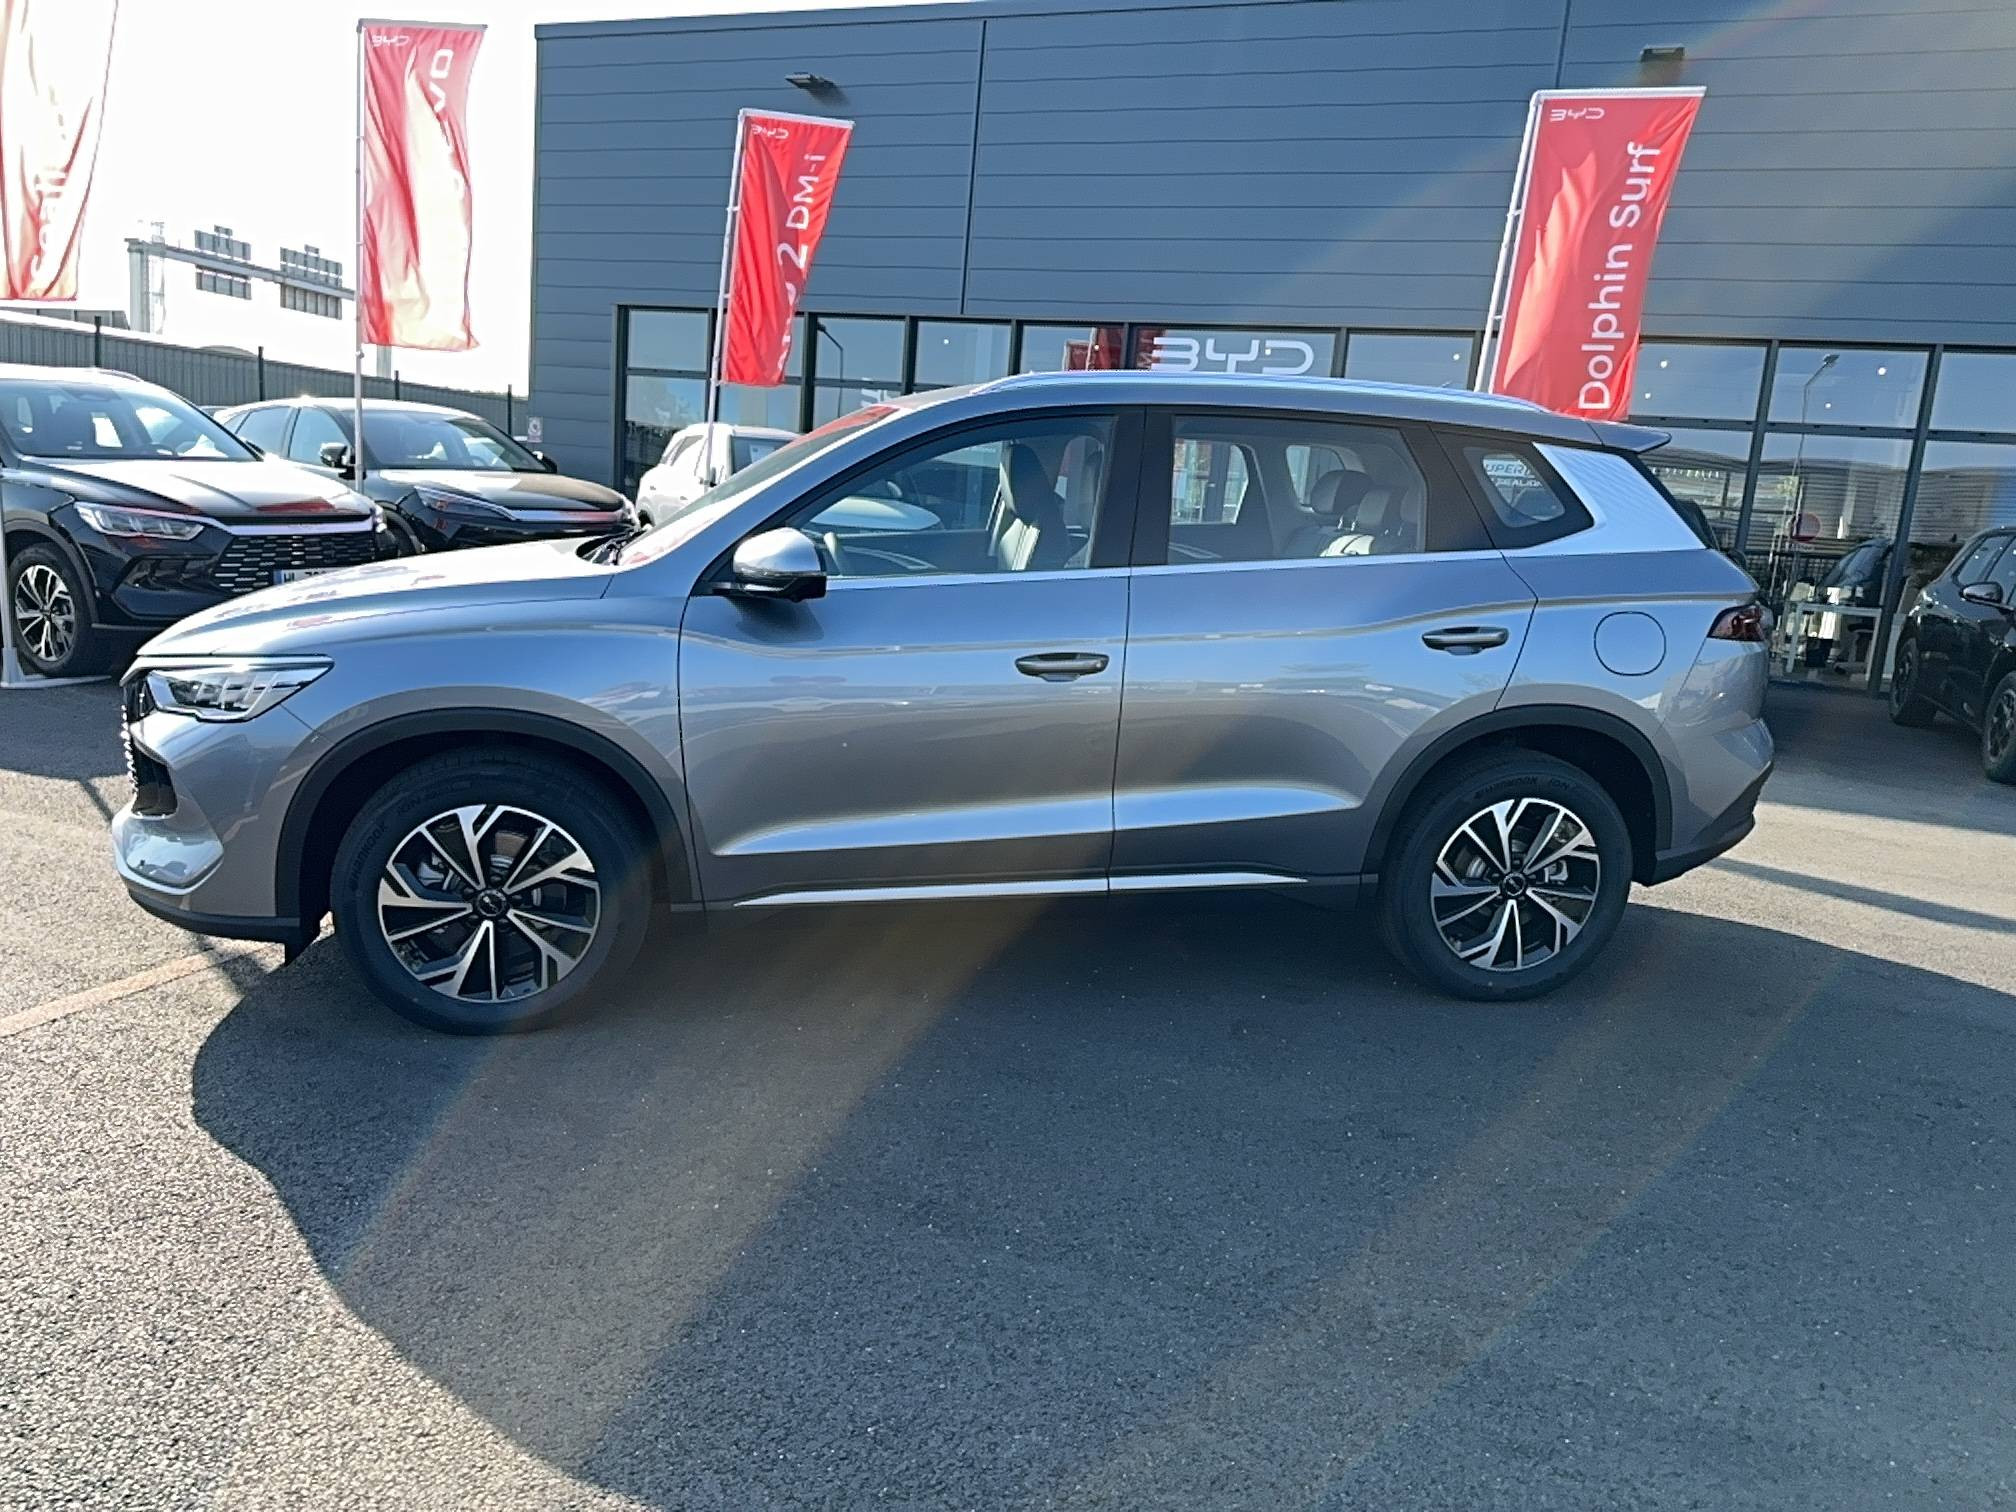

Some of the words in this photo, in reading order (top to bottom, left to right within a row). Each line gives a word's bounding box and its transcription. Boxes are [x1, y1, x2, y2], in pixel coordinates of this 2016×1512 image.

[750, 124, 790, 140] BYD
[1549, 107, 1605, 123] BYD
[785, 153, 827, 231] DM-i
[1578, 243, 1633, 410] Dolphin
[1608, 141, 1662, 229] Surf
[1151, 337, 1315, 376] BYD
